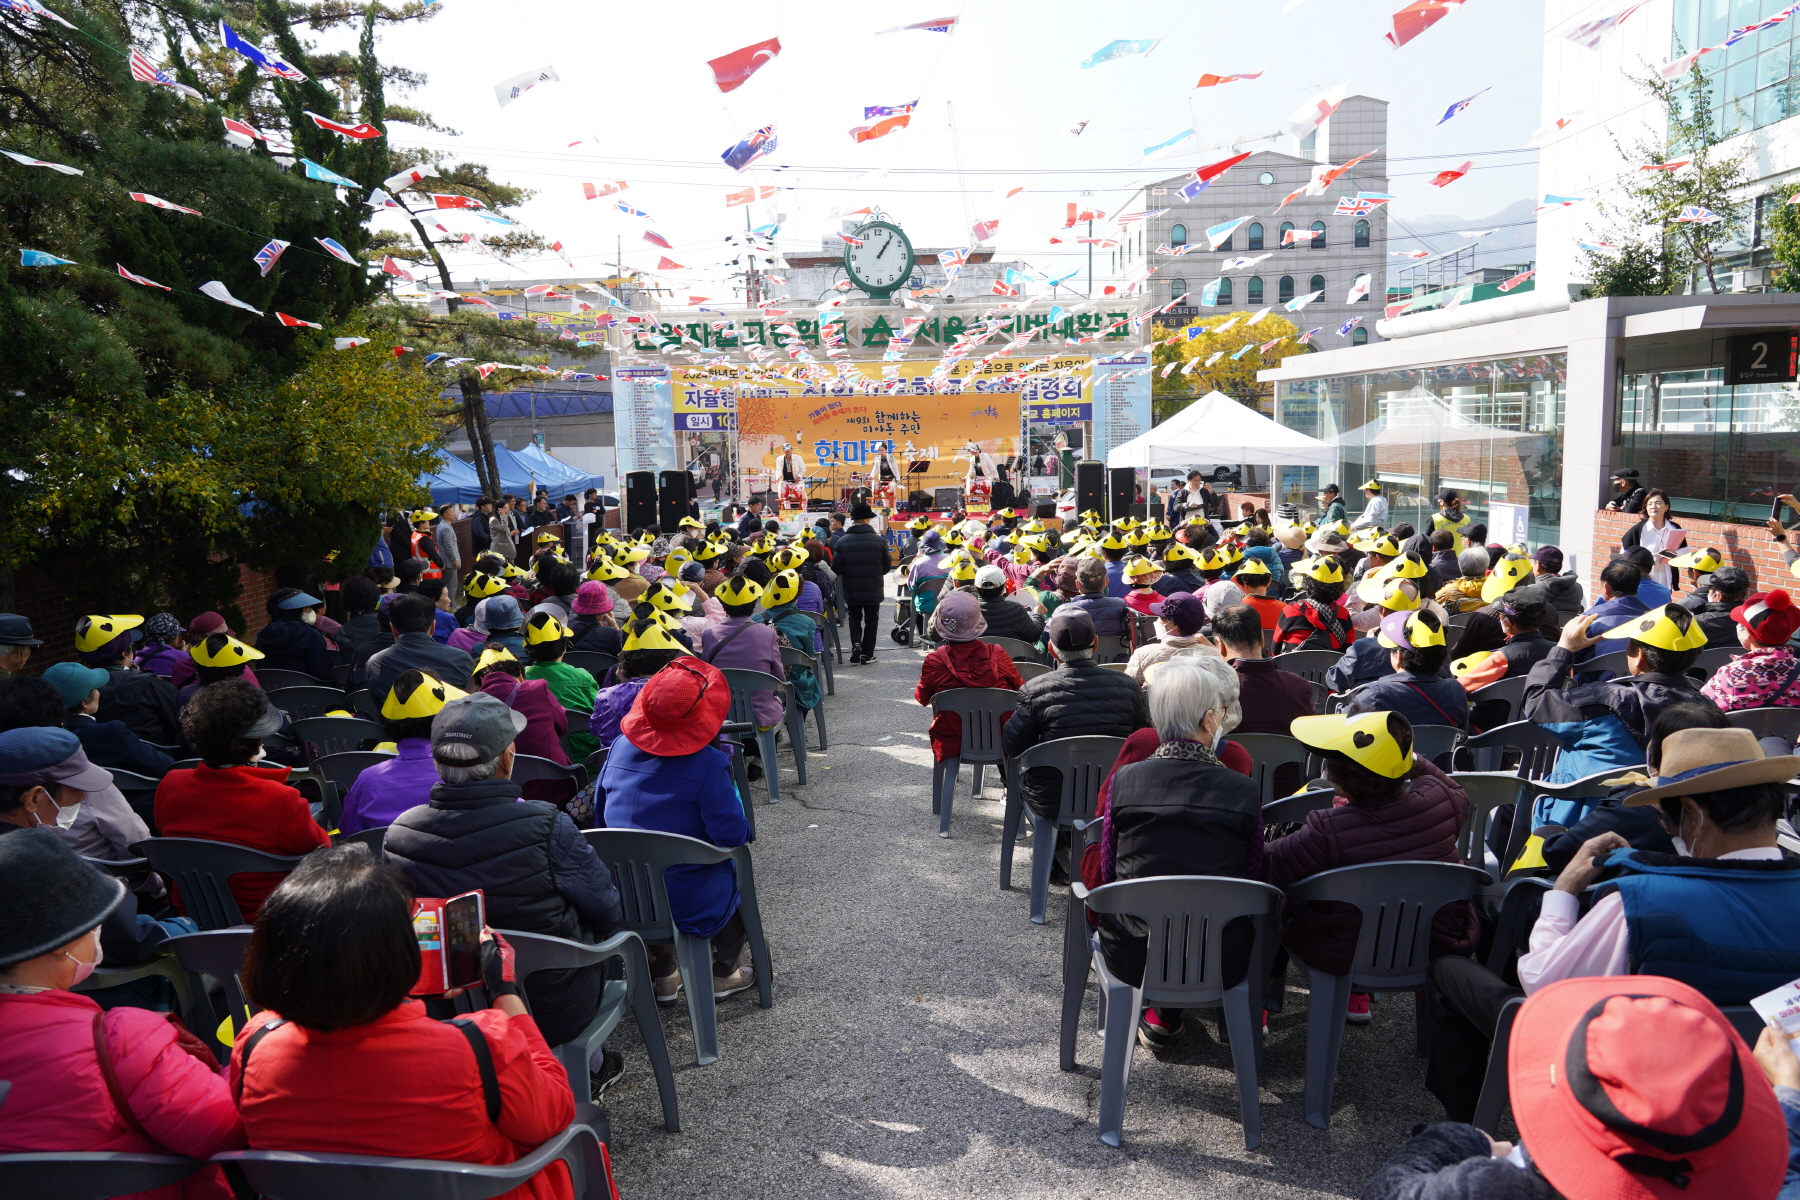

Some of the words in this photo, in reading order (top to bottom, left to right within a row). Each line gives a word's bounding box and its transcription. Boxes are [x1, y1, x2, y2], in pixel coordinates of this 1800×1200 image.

[873, 228, 882, 236] 12
[863, 233, 870, 241] 11
[851, 254, 857, 262] 9
[901, 252, 907, 260] 3
[855, 266, 861, 274] 8
[898, 265, 902, 273] 4
[865, 275, 870, 283] 7
[876, 278, 882, 286] 6
[888, 274, 894, 282] 5
[1750, 341, 1768, 369] 2
[808, 405, 828, 419] 가을이
[827, 400, 842, 410] 왔다
[1041, 407, 1080, 419] 홈페이지
[812, 412, 831, 425] 미아동
[831, 407, 851, 417] 축제가
[846, 416, 870, 425] 제9회
[874, 410, 922, 424] 함께하는
[690, 416, 710, 427] 일시
[862, 422, 895, 436] 미아동
[900, 422, 921, 435] 주민
[903, 439, 939, 462] 축제
